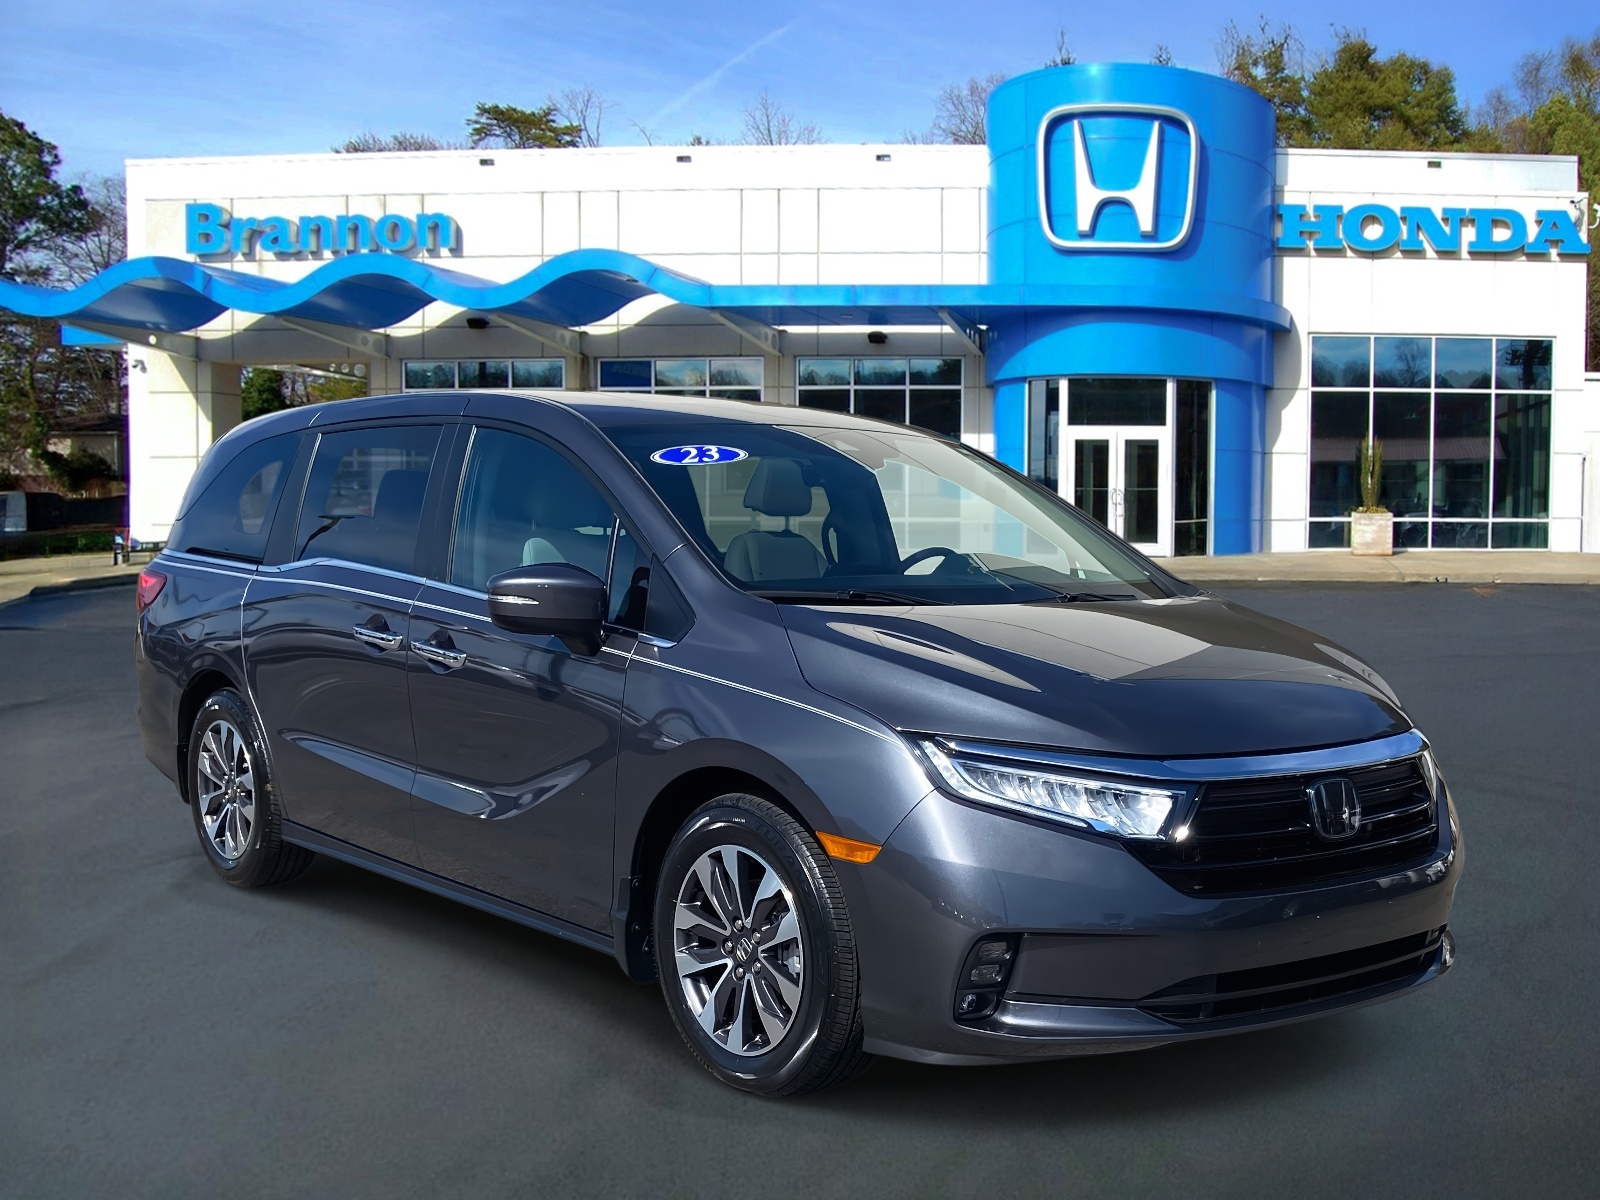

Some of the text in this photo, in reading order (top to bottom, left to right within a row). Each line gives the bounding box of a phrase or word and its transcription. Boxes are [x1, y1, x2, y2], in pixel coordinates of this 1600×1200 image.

[186, 203, 458, 254] Brannon
[1276, 203, 1591, 254] HONDA
[680, 446, 720, 464] 23
